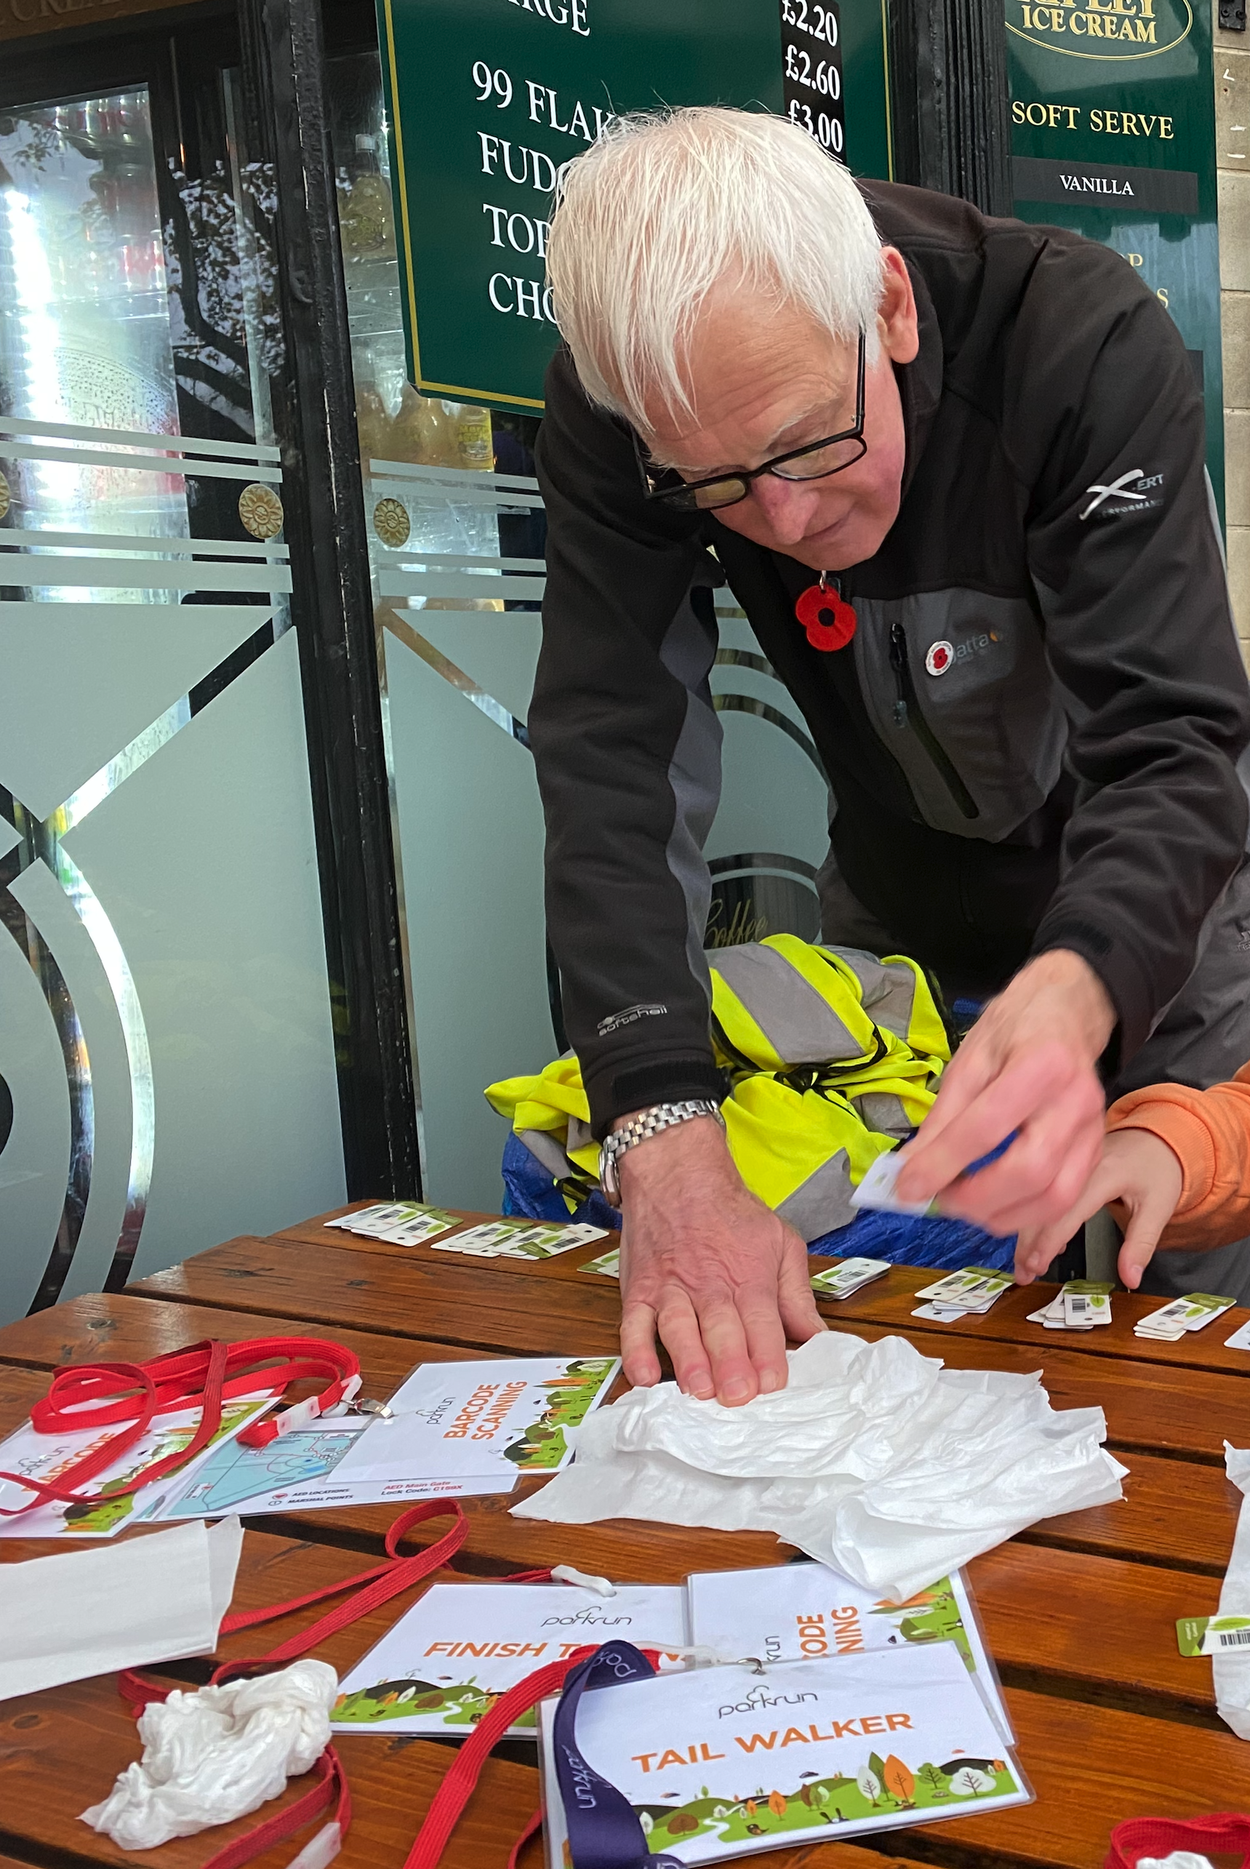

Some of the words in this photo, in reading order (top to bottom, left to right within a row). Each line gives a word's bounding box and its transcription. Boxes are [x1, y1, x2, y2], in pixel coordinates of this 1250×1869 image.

[782, 0, 838, 47] £2.20
[1021, 5, 1066, 32] ICE
[1069, 11, 1158, 44] CREAM
[472, 60, 513, 109] 99
[785, 44, 841, 100] £2.60
[1011, 101, 1080, 130] SOFT
[1090, 109, 1174, 140] SERVE
[1059, 174, 1135, 196] VANILLA
[443, 1384, 501, 1438] BARCODE
[471, 1381, 528, 1440] SCANNING
[541, 1606, 633, 1628] parkrun
[423, 1642, 548, 1658] FINISH
[717, 1685, 818, 1719] parkrun
[631, 1742, 726, 1773] TAIL
[734, 1713, 915, 1754] WALKER
